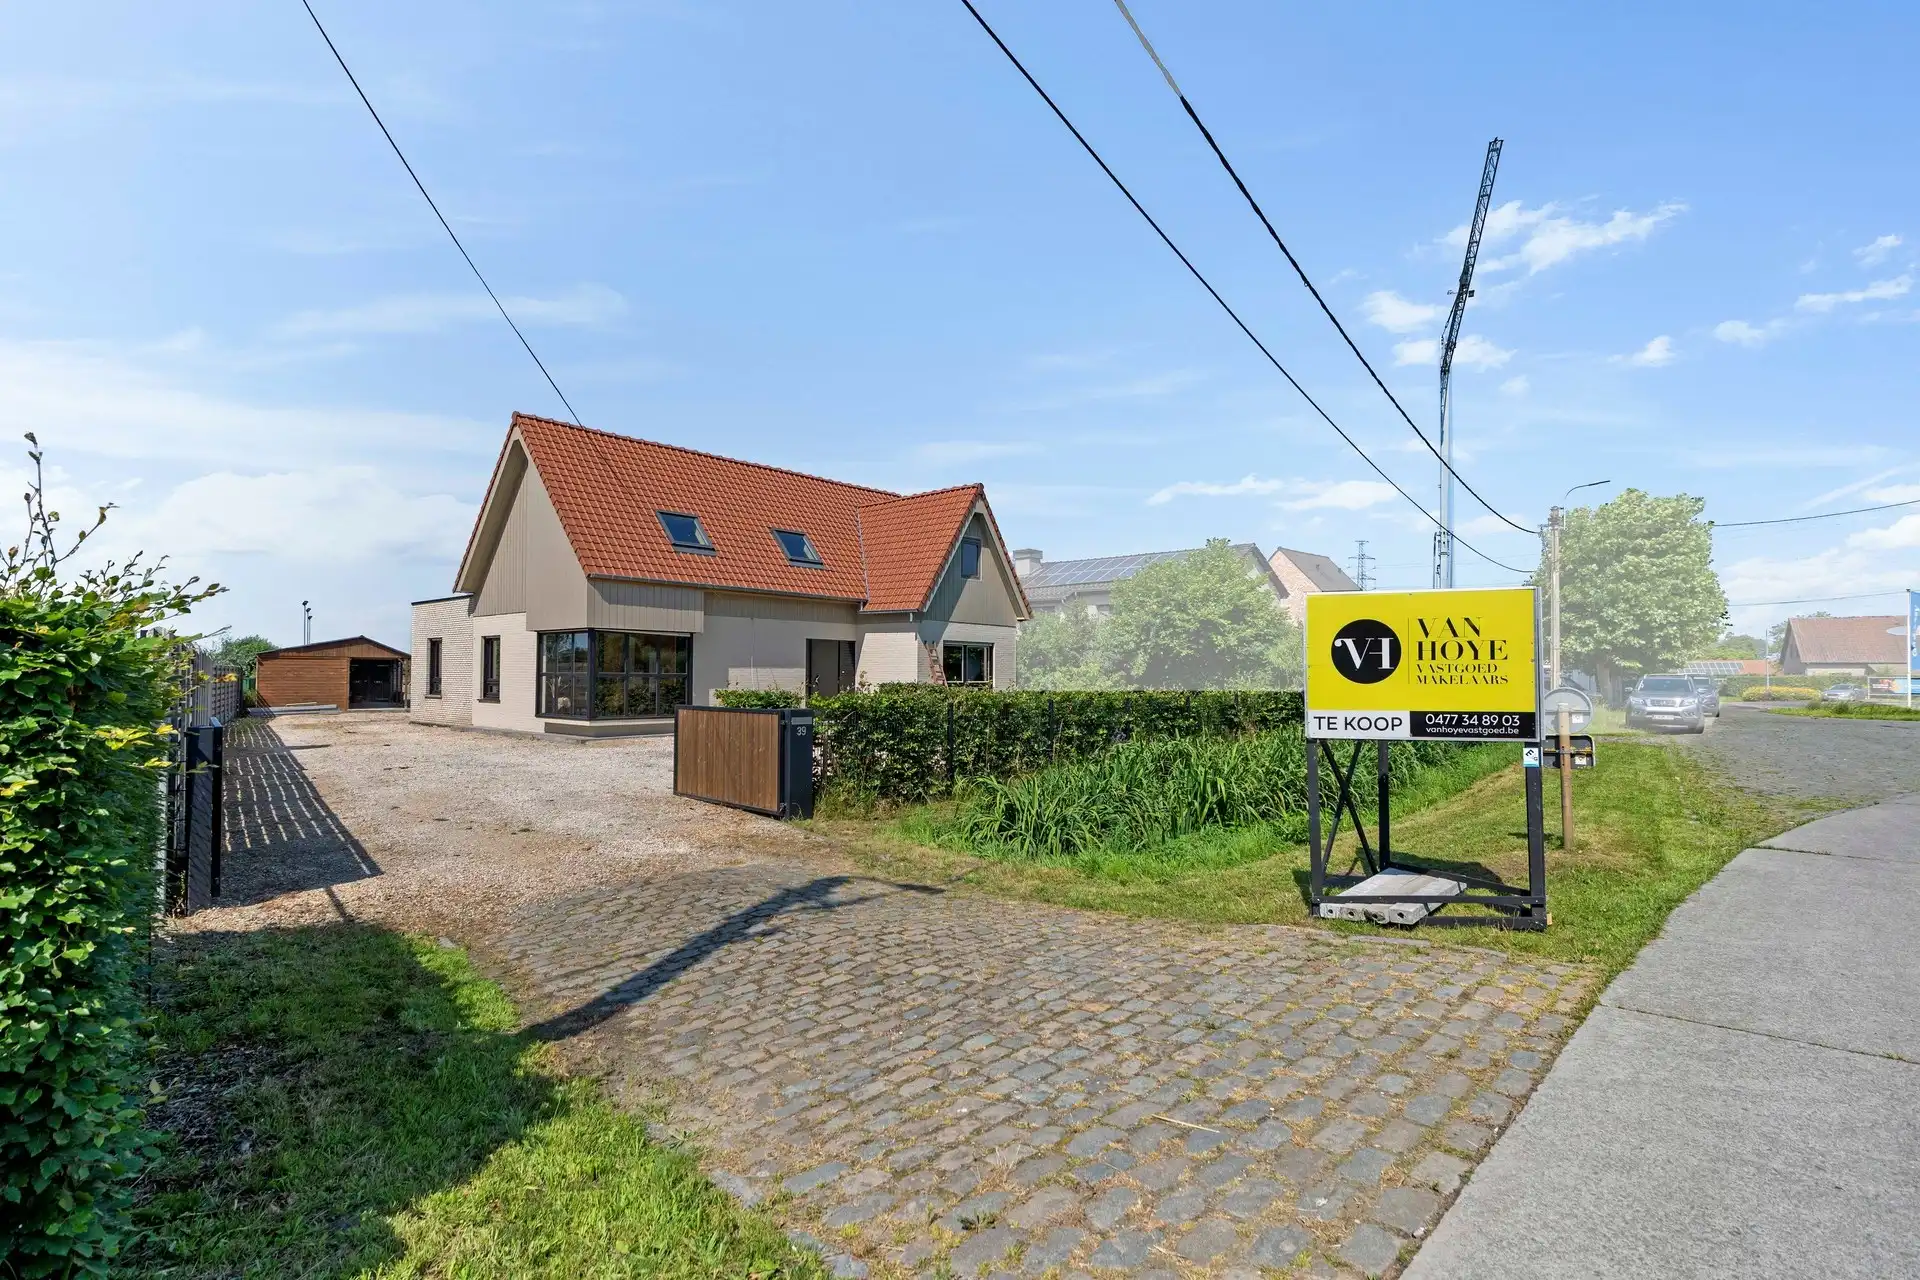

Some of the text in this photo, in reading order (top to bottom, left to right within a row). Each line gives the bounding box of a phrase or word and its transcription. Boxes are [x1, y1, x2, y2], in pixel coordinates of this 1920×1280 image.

[1416, 616, 1483, 638] VAN
[1416, 640, 1508, 661] HOYE
[1416, 663, 1498, 673] VASTGOED
[1416, 675, 1508, 685] MAKELAARS
[1313, 716, 1403, 731] TE KOOP
[1425, 713, 1520, 726] 0477 34 89 03
[796, 726, 806, 736] 39
[1426, 726, 1519, 735] vanhoyevastgoed.be
